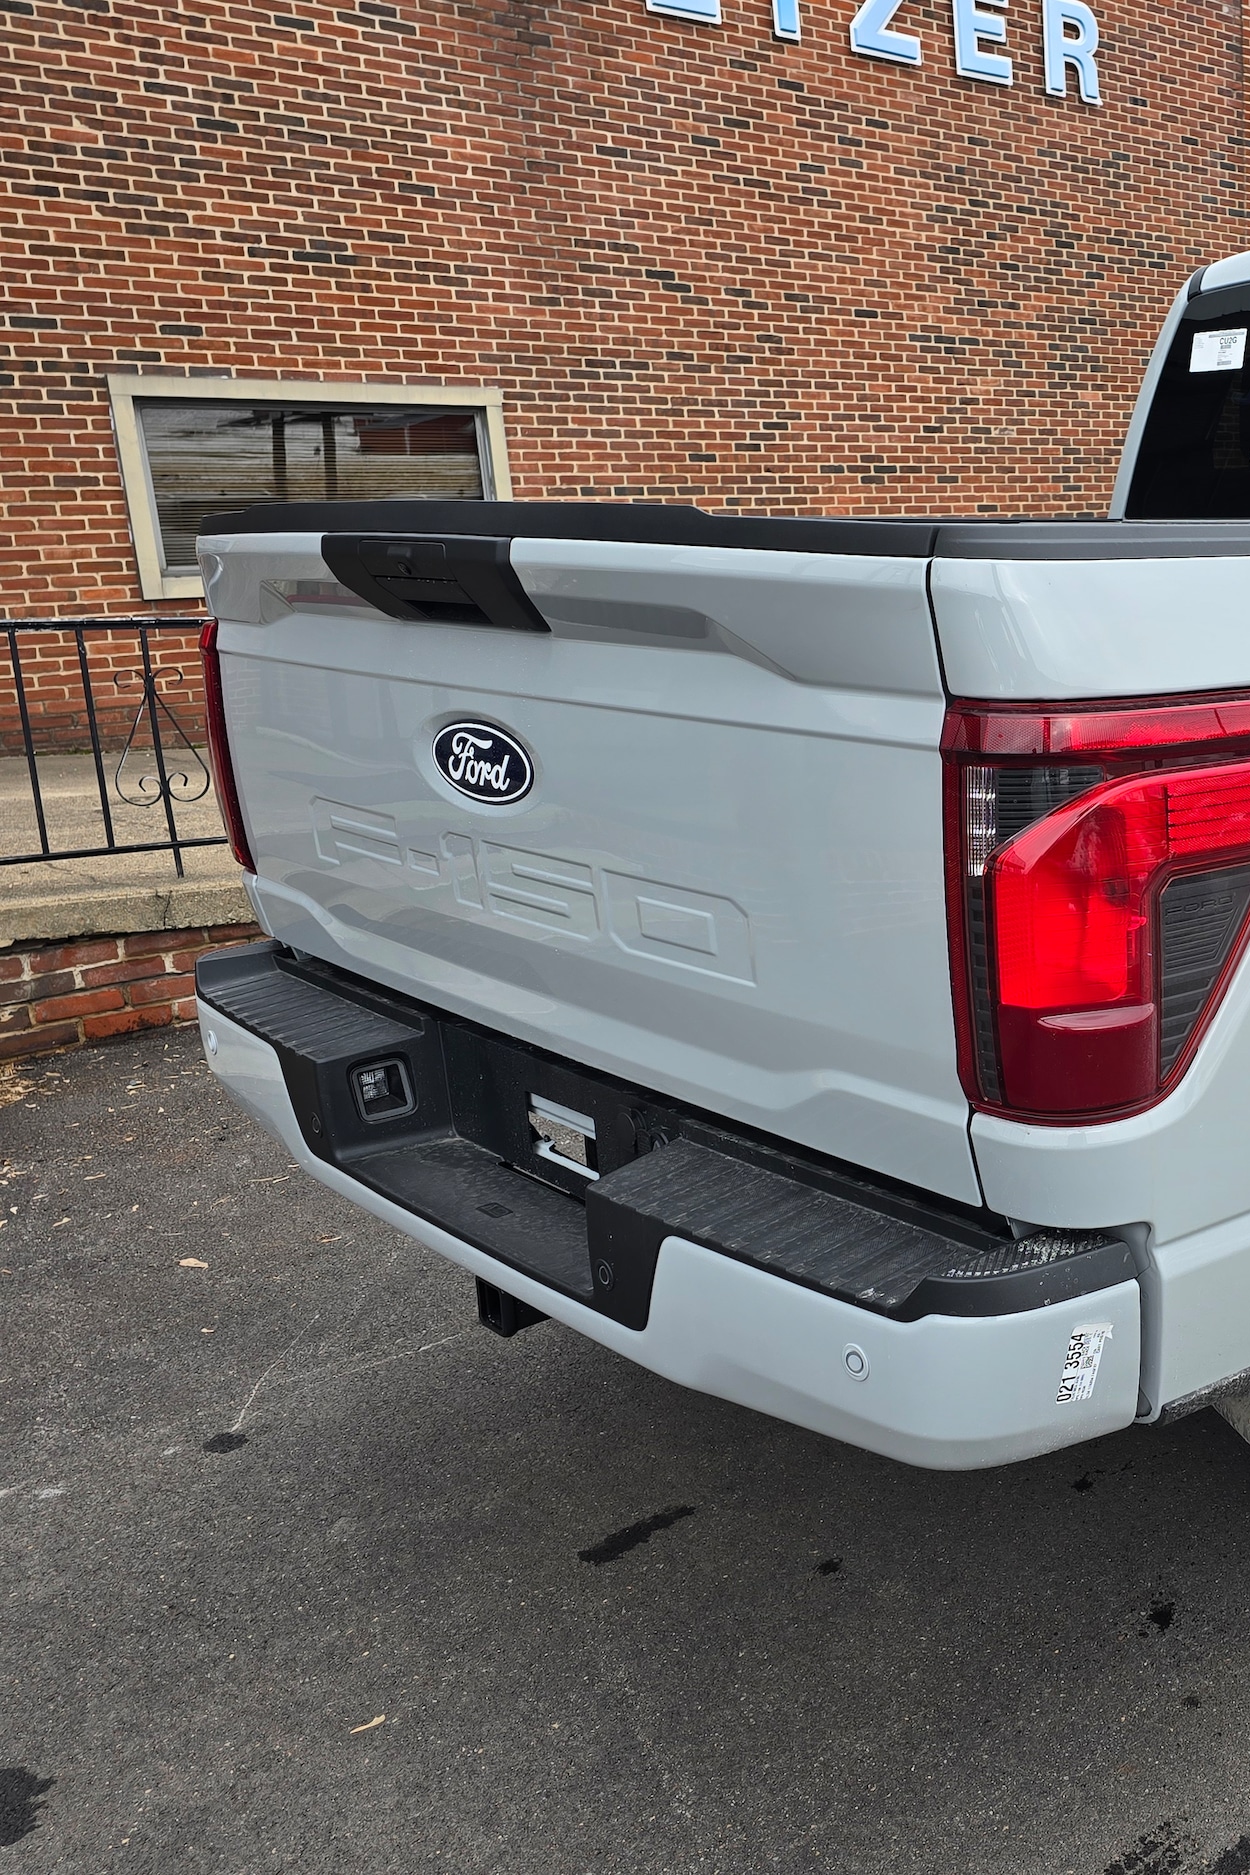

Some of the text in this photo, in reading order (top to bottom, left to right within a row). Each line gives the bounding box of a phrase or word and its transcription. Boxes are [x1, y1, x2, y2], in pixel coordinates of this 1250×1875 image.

[647, 0, 1103, 105] ZER
[1219, 336, 1238, 345] CU2G
[448, 732, 510, 791] Ford
[310, 796, 757, 988] F-150
[1165, 896, 1233, 917] FORD
[1064, 1333, 1085, 1370] 3554
[1056, 1376, 1076, 1402] 021
